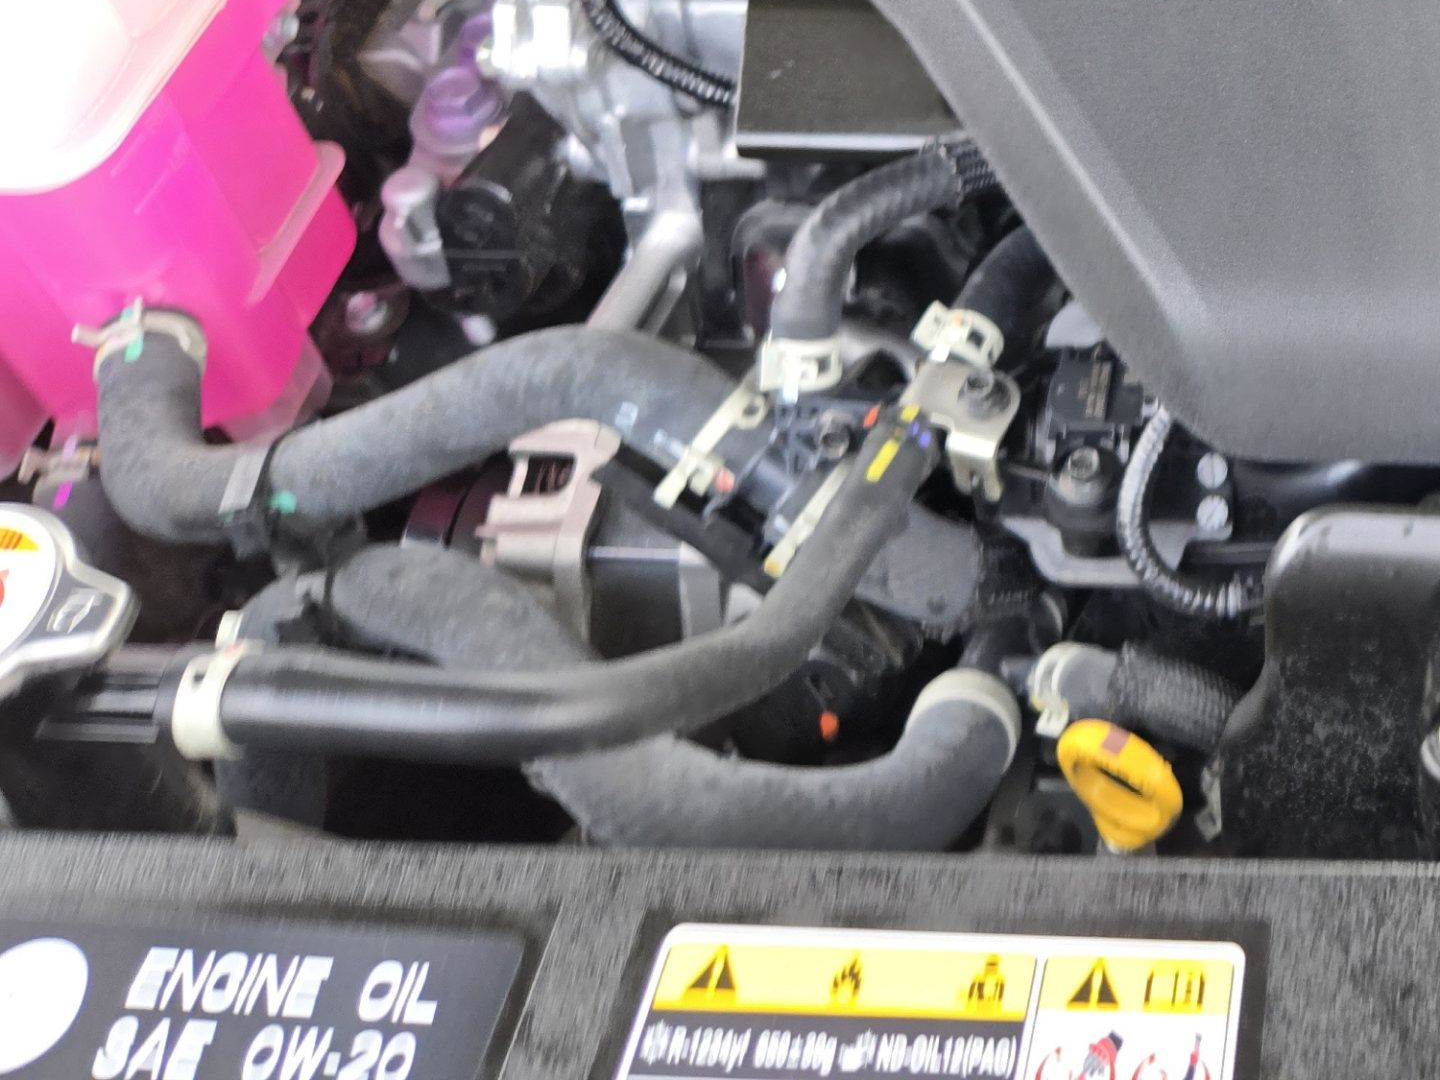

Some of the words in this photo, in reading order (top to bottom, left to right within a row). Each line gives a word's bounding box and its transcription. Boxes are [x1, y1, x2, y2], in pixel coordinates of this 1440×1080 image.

[124, 946, 334, 1019] ENGINE
[357, 959, 438, 1024] OIL
[91, 1015, 218, 1080] SAE
